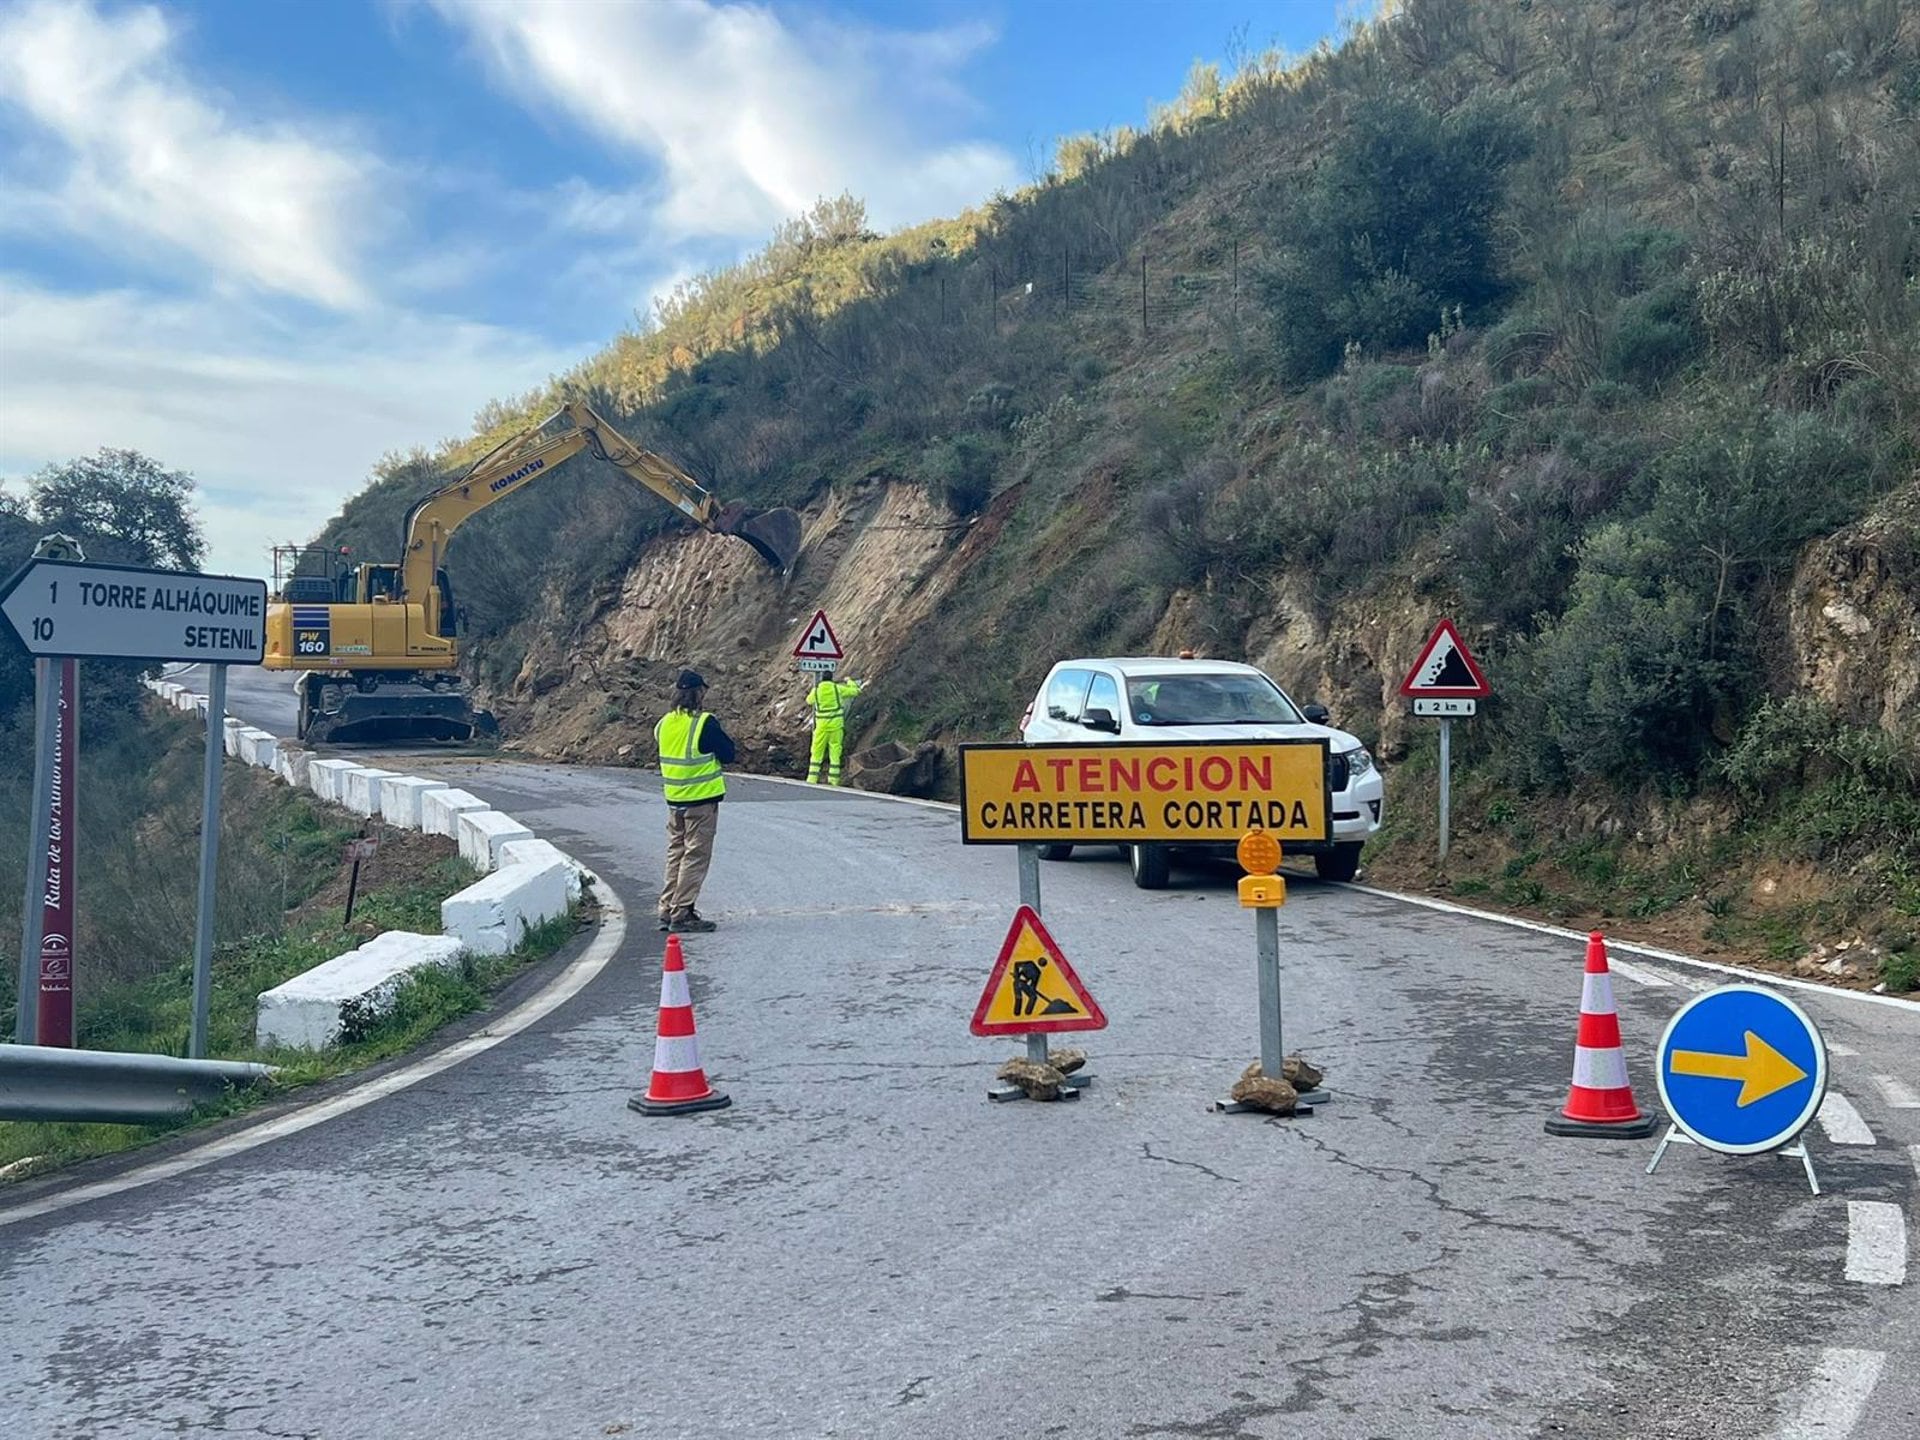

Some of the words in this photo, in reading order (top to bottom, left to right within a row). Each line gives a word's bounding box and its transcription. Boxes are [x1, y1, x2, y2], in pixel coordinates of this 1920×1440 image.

[489, 458, 544, 492] KOMATSU
[50, 581, 57, 604] 1
[79, 582, 146, 609] TORRE
[151, 586, 260, 616] ALHÁQUIME
[32, 617, 55, 641] 10
[184, 626, 257, 650] SETENIL
[299, 631, 319, 641] PW
[299, 641, 325, 653] 160
[1433, 703, 1440, 711] 2
[1445, 702, 1458, 711] km
[1012, 756, 1272, 793] ATENCION
[981, 802, 1146, 829] CARRETERA
[1164, 801, 1308, 829] CORTADA
[49, 818, 61, 841] los
[48, 845, 61, 863] de
[44, 868, 61, 910] Ruta
